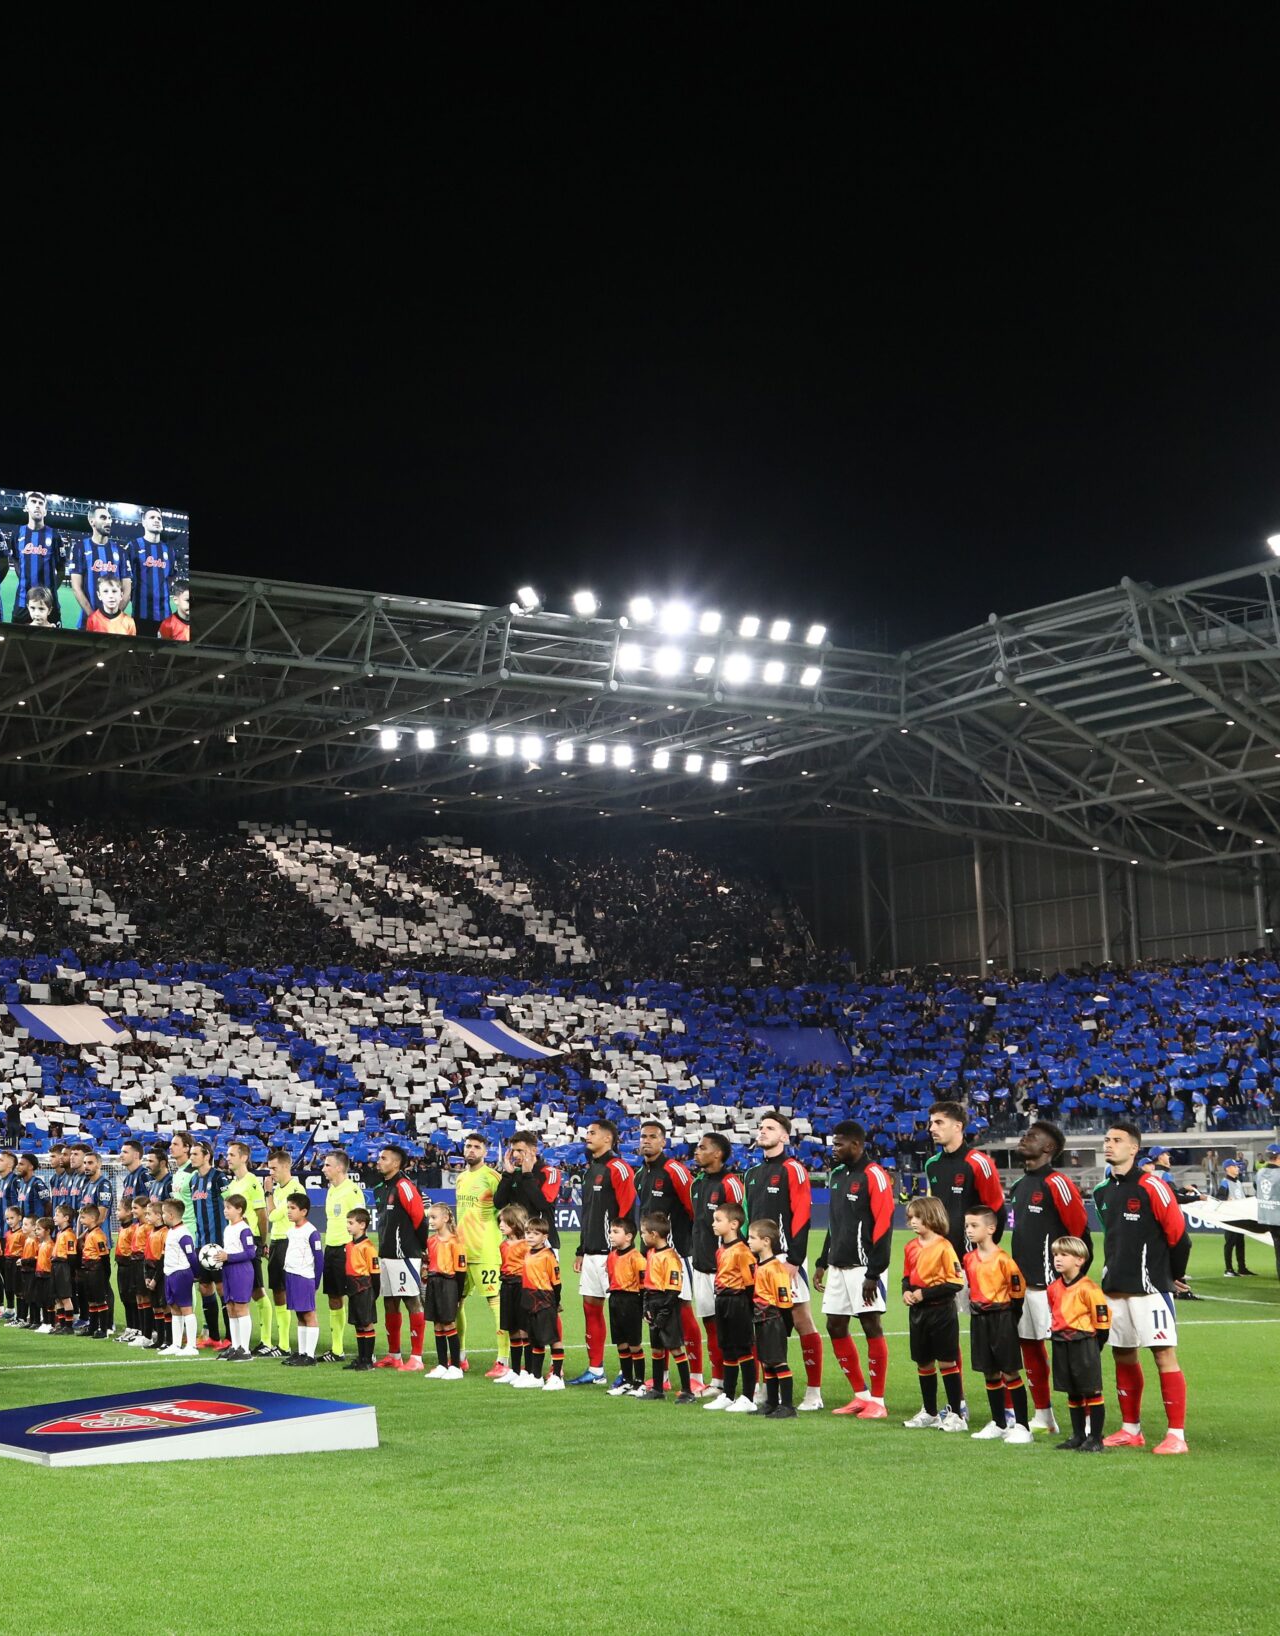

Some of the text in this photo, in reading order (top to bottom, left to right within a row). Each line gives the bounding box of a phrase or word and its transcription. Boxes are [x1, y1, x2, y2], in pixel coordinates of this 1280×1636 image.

[399, 1271, 407, 1286] 9
[481, 1269, 497, 1285] 22
[1151, 1309, 1168, 1329] 11
